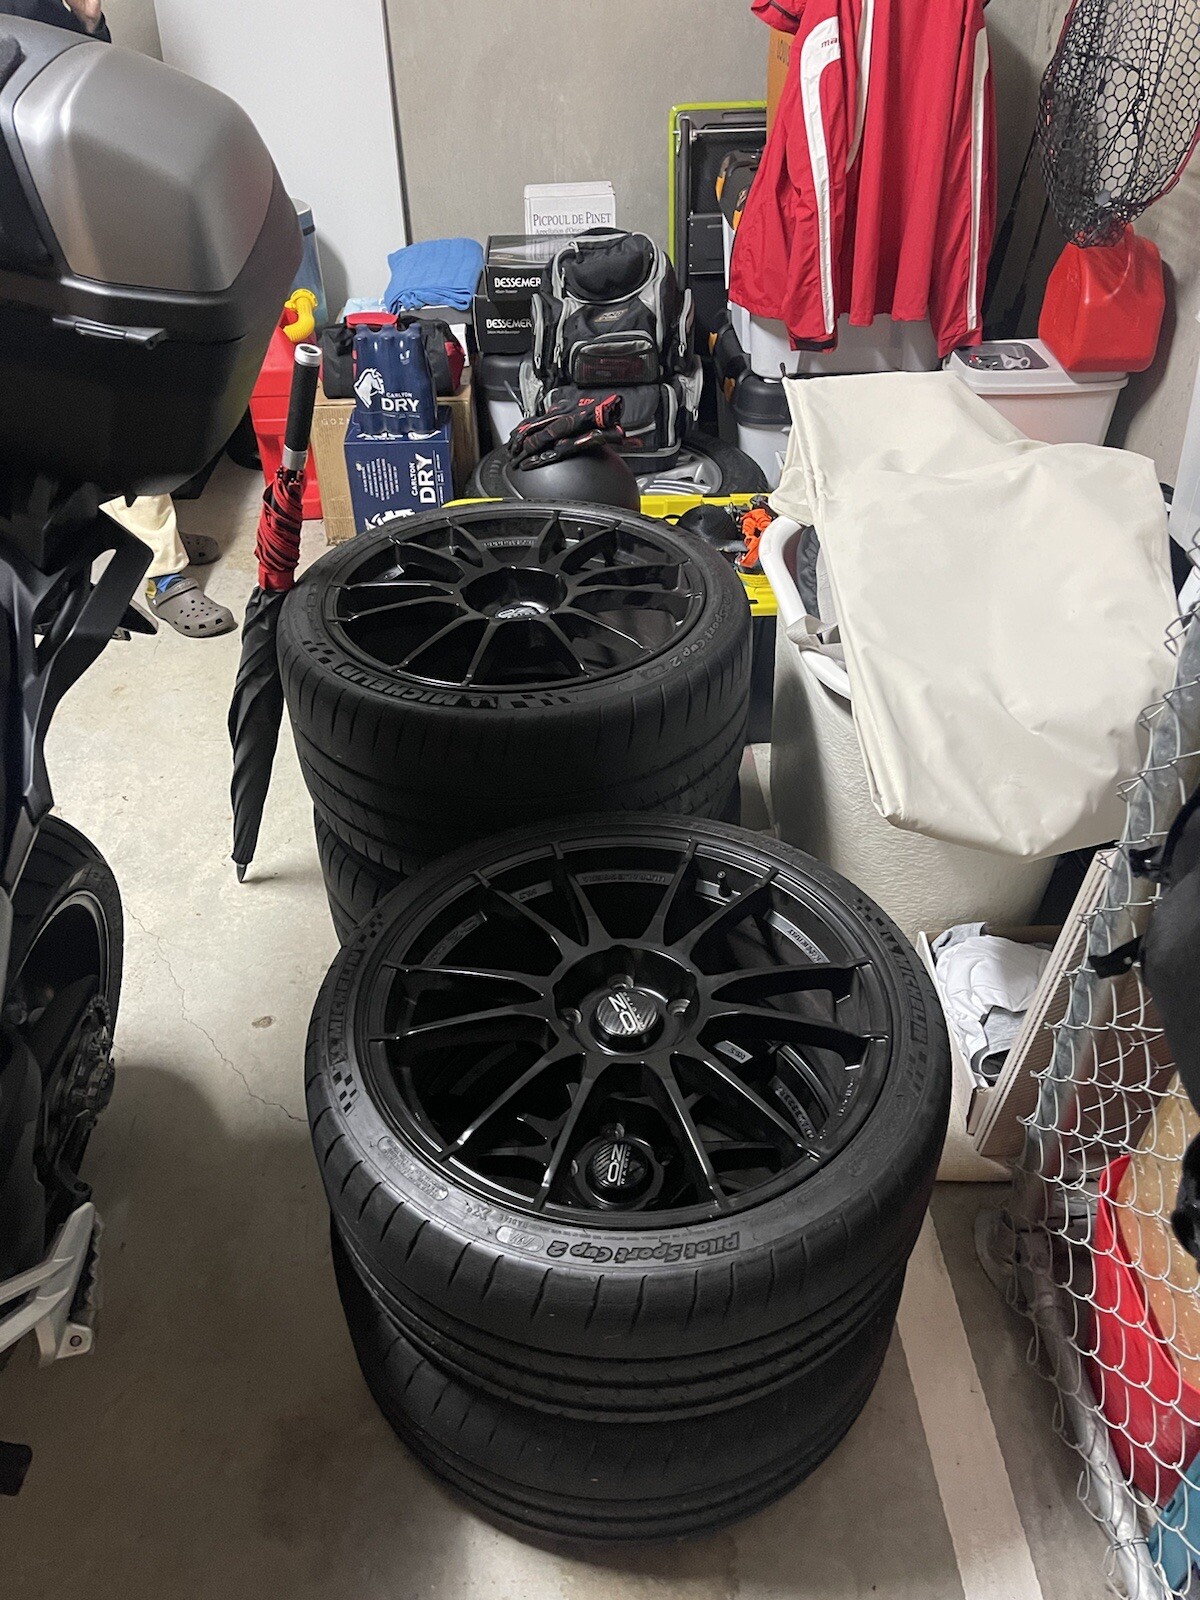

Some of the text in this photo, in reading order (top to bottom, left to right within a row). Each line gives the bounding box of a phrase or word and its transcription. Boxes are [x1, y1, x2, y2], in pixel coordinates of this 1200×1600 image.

[533, 211, 611, 226] PICPOUL DE PINET
[494, 277, 541, 288] BESSEMER
[486, 318, 532, 329] BESSEMER
[381, 397, 419, 412] DRY
[409, 462, 419, 497] CARLTON
[415, 453, 437, 504] DRY
[334, 663, 463, 706] MICHELIN
[329, 949, 362, 1035] MICHELIN
[893, 953, 927, 1043] MICHELIN
[547, 1240, 569, 1258] 2
[570, 1241, 614, 1263] Cup
[614, 1239, 686, 1264] Sport
[684, 1230, 740, 1260] Pilot
